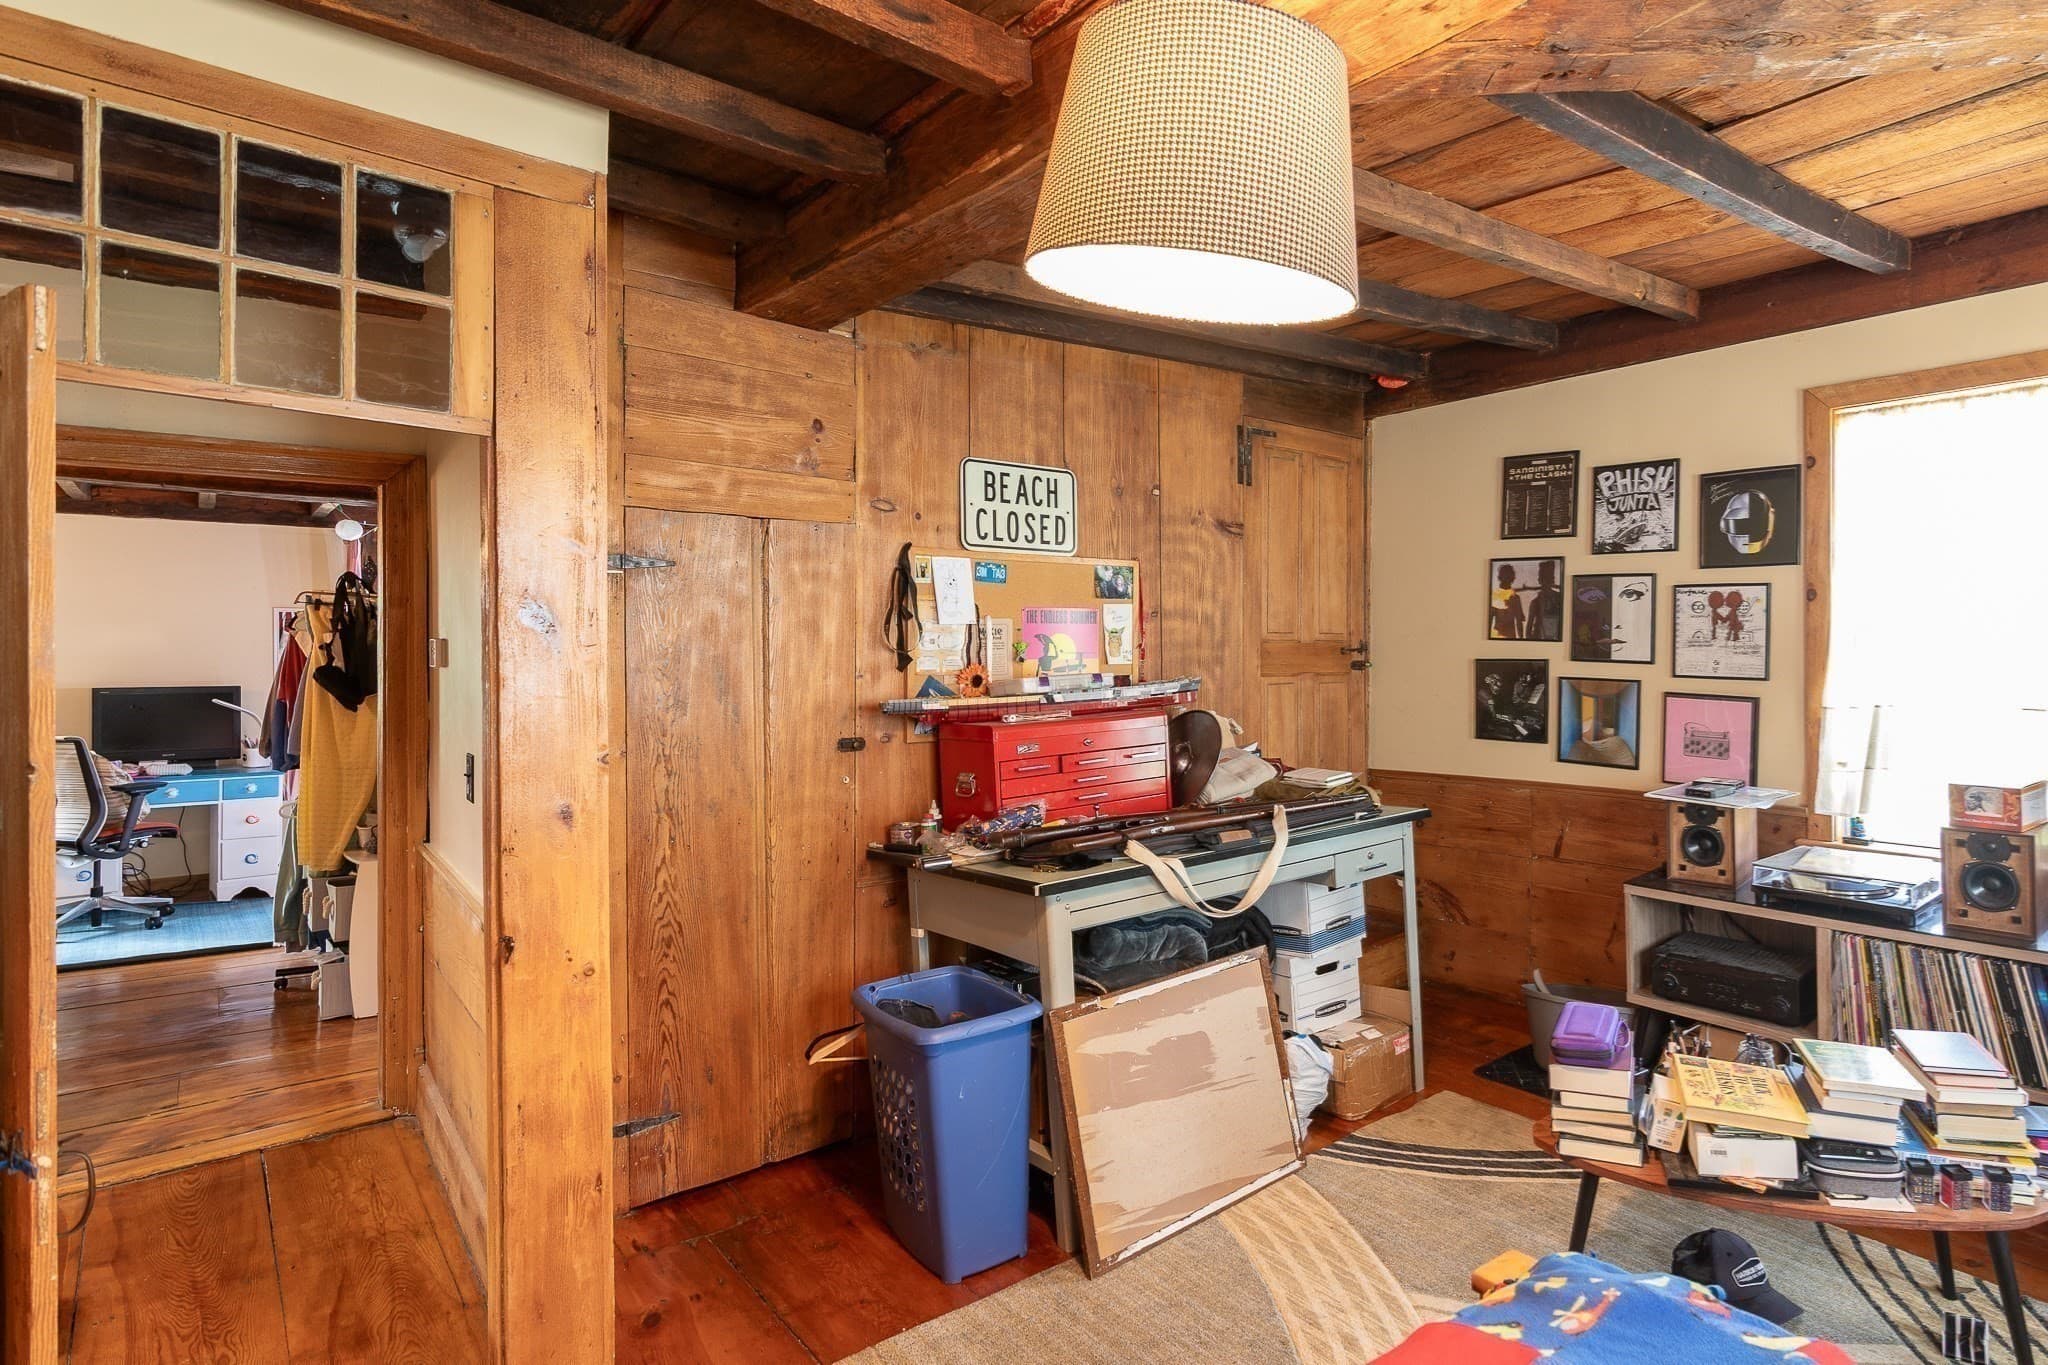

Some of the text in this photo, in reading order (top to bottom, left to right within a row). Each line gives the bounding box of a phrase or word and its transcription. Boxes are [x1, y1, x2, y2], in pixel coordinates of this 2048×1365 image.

[1534, 470, 1567, 479] CLASH
[1597, 465, 1673, 498] PHISH
[984, 470, 1058, 508] BEACH
[1607, 493, 1660, 512] JUNTA
[976, 508, 1066, 546] CLOSED
[1026, 609, 1038, 624] THE
